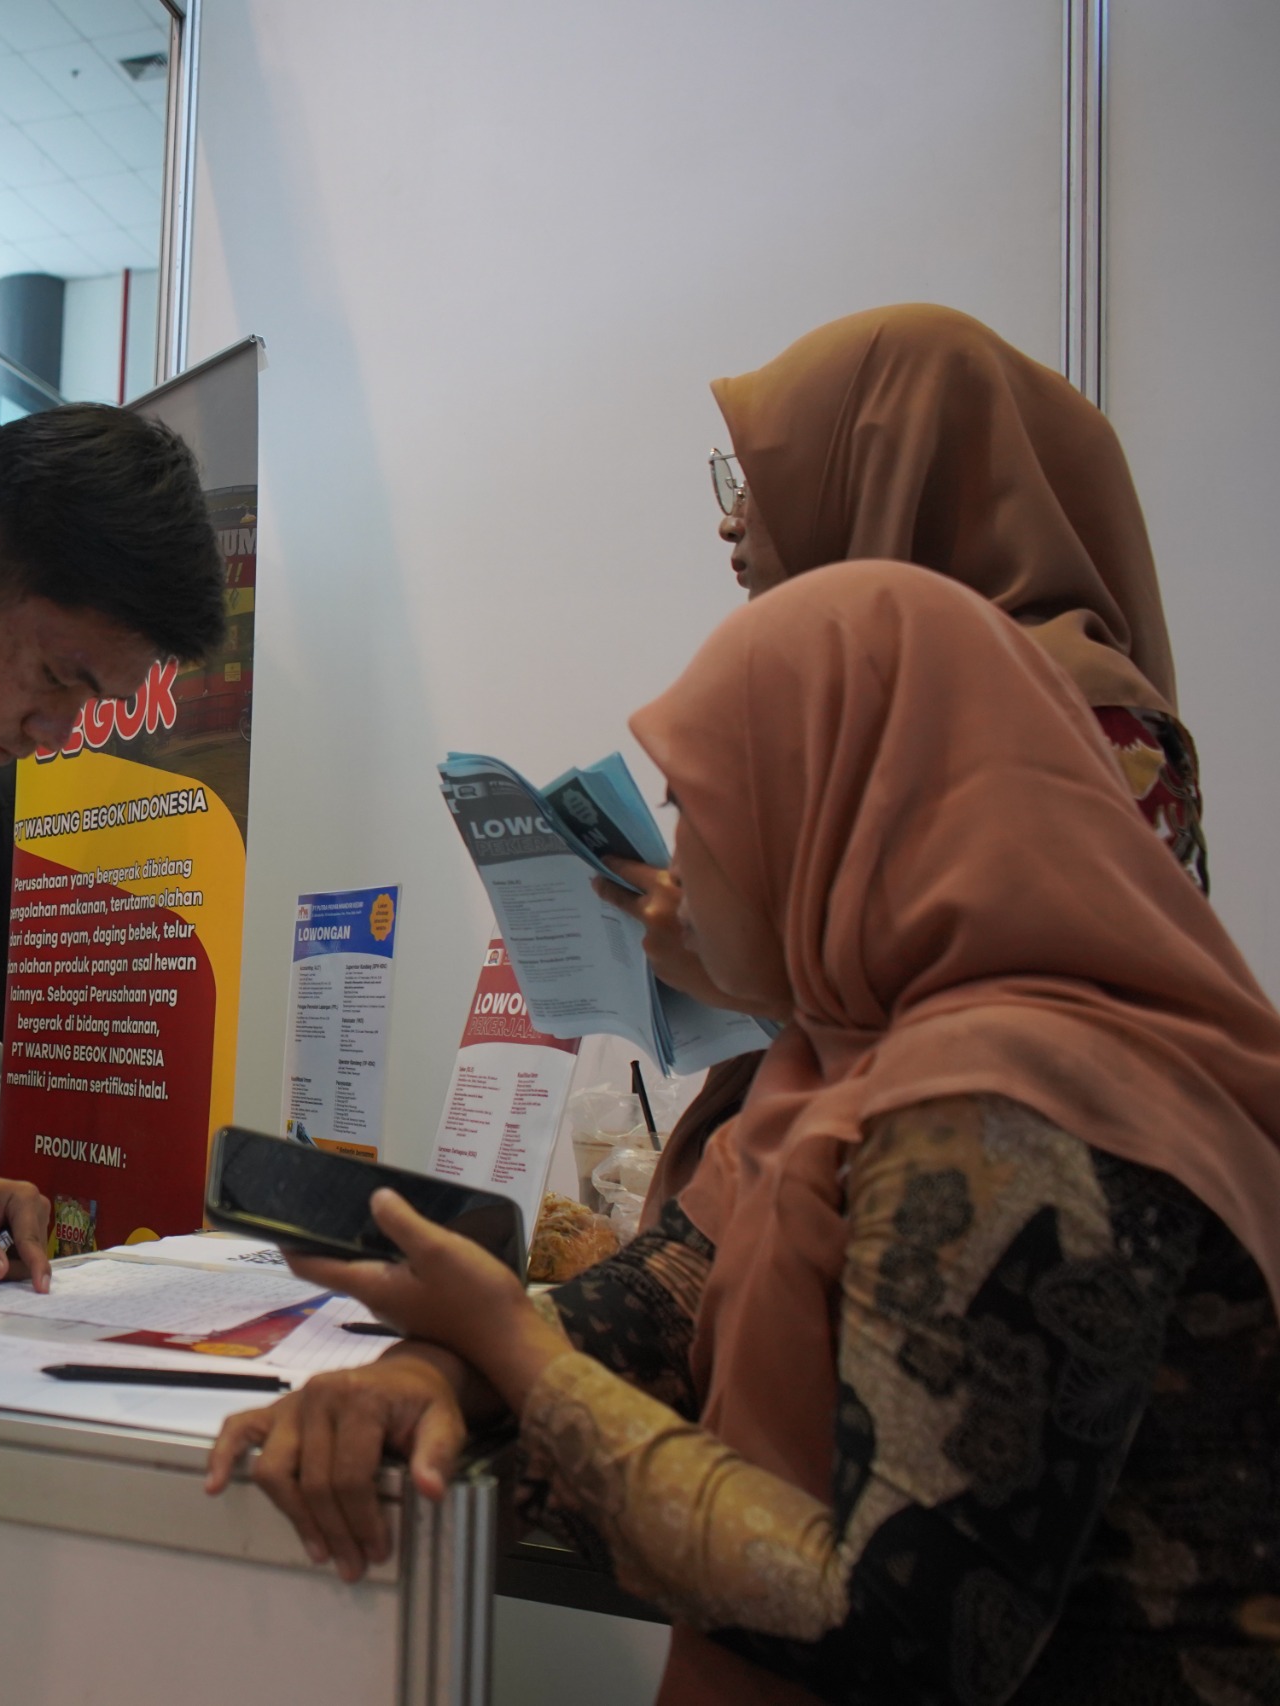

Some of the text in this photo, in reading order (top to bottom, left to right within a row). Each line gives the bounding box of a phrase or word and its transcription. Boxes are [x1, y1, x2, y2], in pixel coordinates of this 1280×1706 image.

[35, 655, 179, 765] GOK
[14, 787, 208, 841] PT WARUNG BEGOK INDONESIA
[14, 857, 192, 892] Perusahaan yang bergerak dibidang
[60, 898, 108, 916] makanan,
[110, 894, 155, 912] terutama
[158, 888, 203, 907] olahan
[23, 929, 58, 949] daging
[60, 930, 91, 946] ayam,
[93, 924, 126, 945] daging
[128, 923, 161, 941] bebek,
[163, 919, 195, 938] telur
[298, 925, 351, 942] LOWONGAN
[19, 957, 52, 973] olahan
[54, 956, 89, 976] produk
[91, 959, 128, 976] pangan
[132, 953, 153, 971] asal
[154, 953, 196, 971] hewan
[10, 985, 177, 1007] lainnya. Sebagai Perusahaan yang
[17, 1013, 160, 1037] bergerak di bidang makanan,
[467, 1016, 542, 1039] PEKERJAA
[11, 1041, 164, 1067] PT WARUNG BEGOK INDONESIA
[6, 1069, 168, 1100] memiliki jaminan sertifikasi halal.
[34, 1134, 87, 1162] PRODUK
[89, 1142, 121, 1168] KAMI
[55, 1221, 86, 1246] BEGOK
